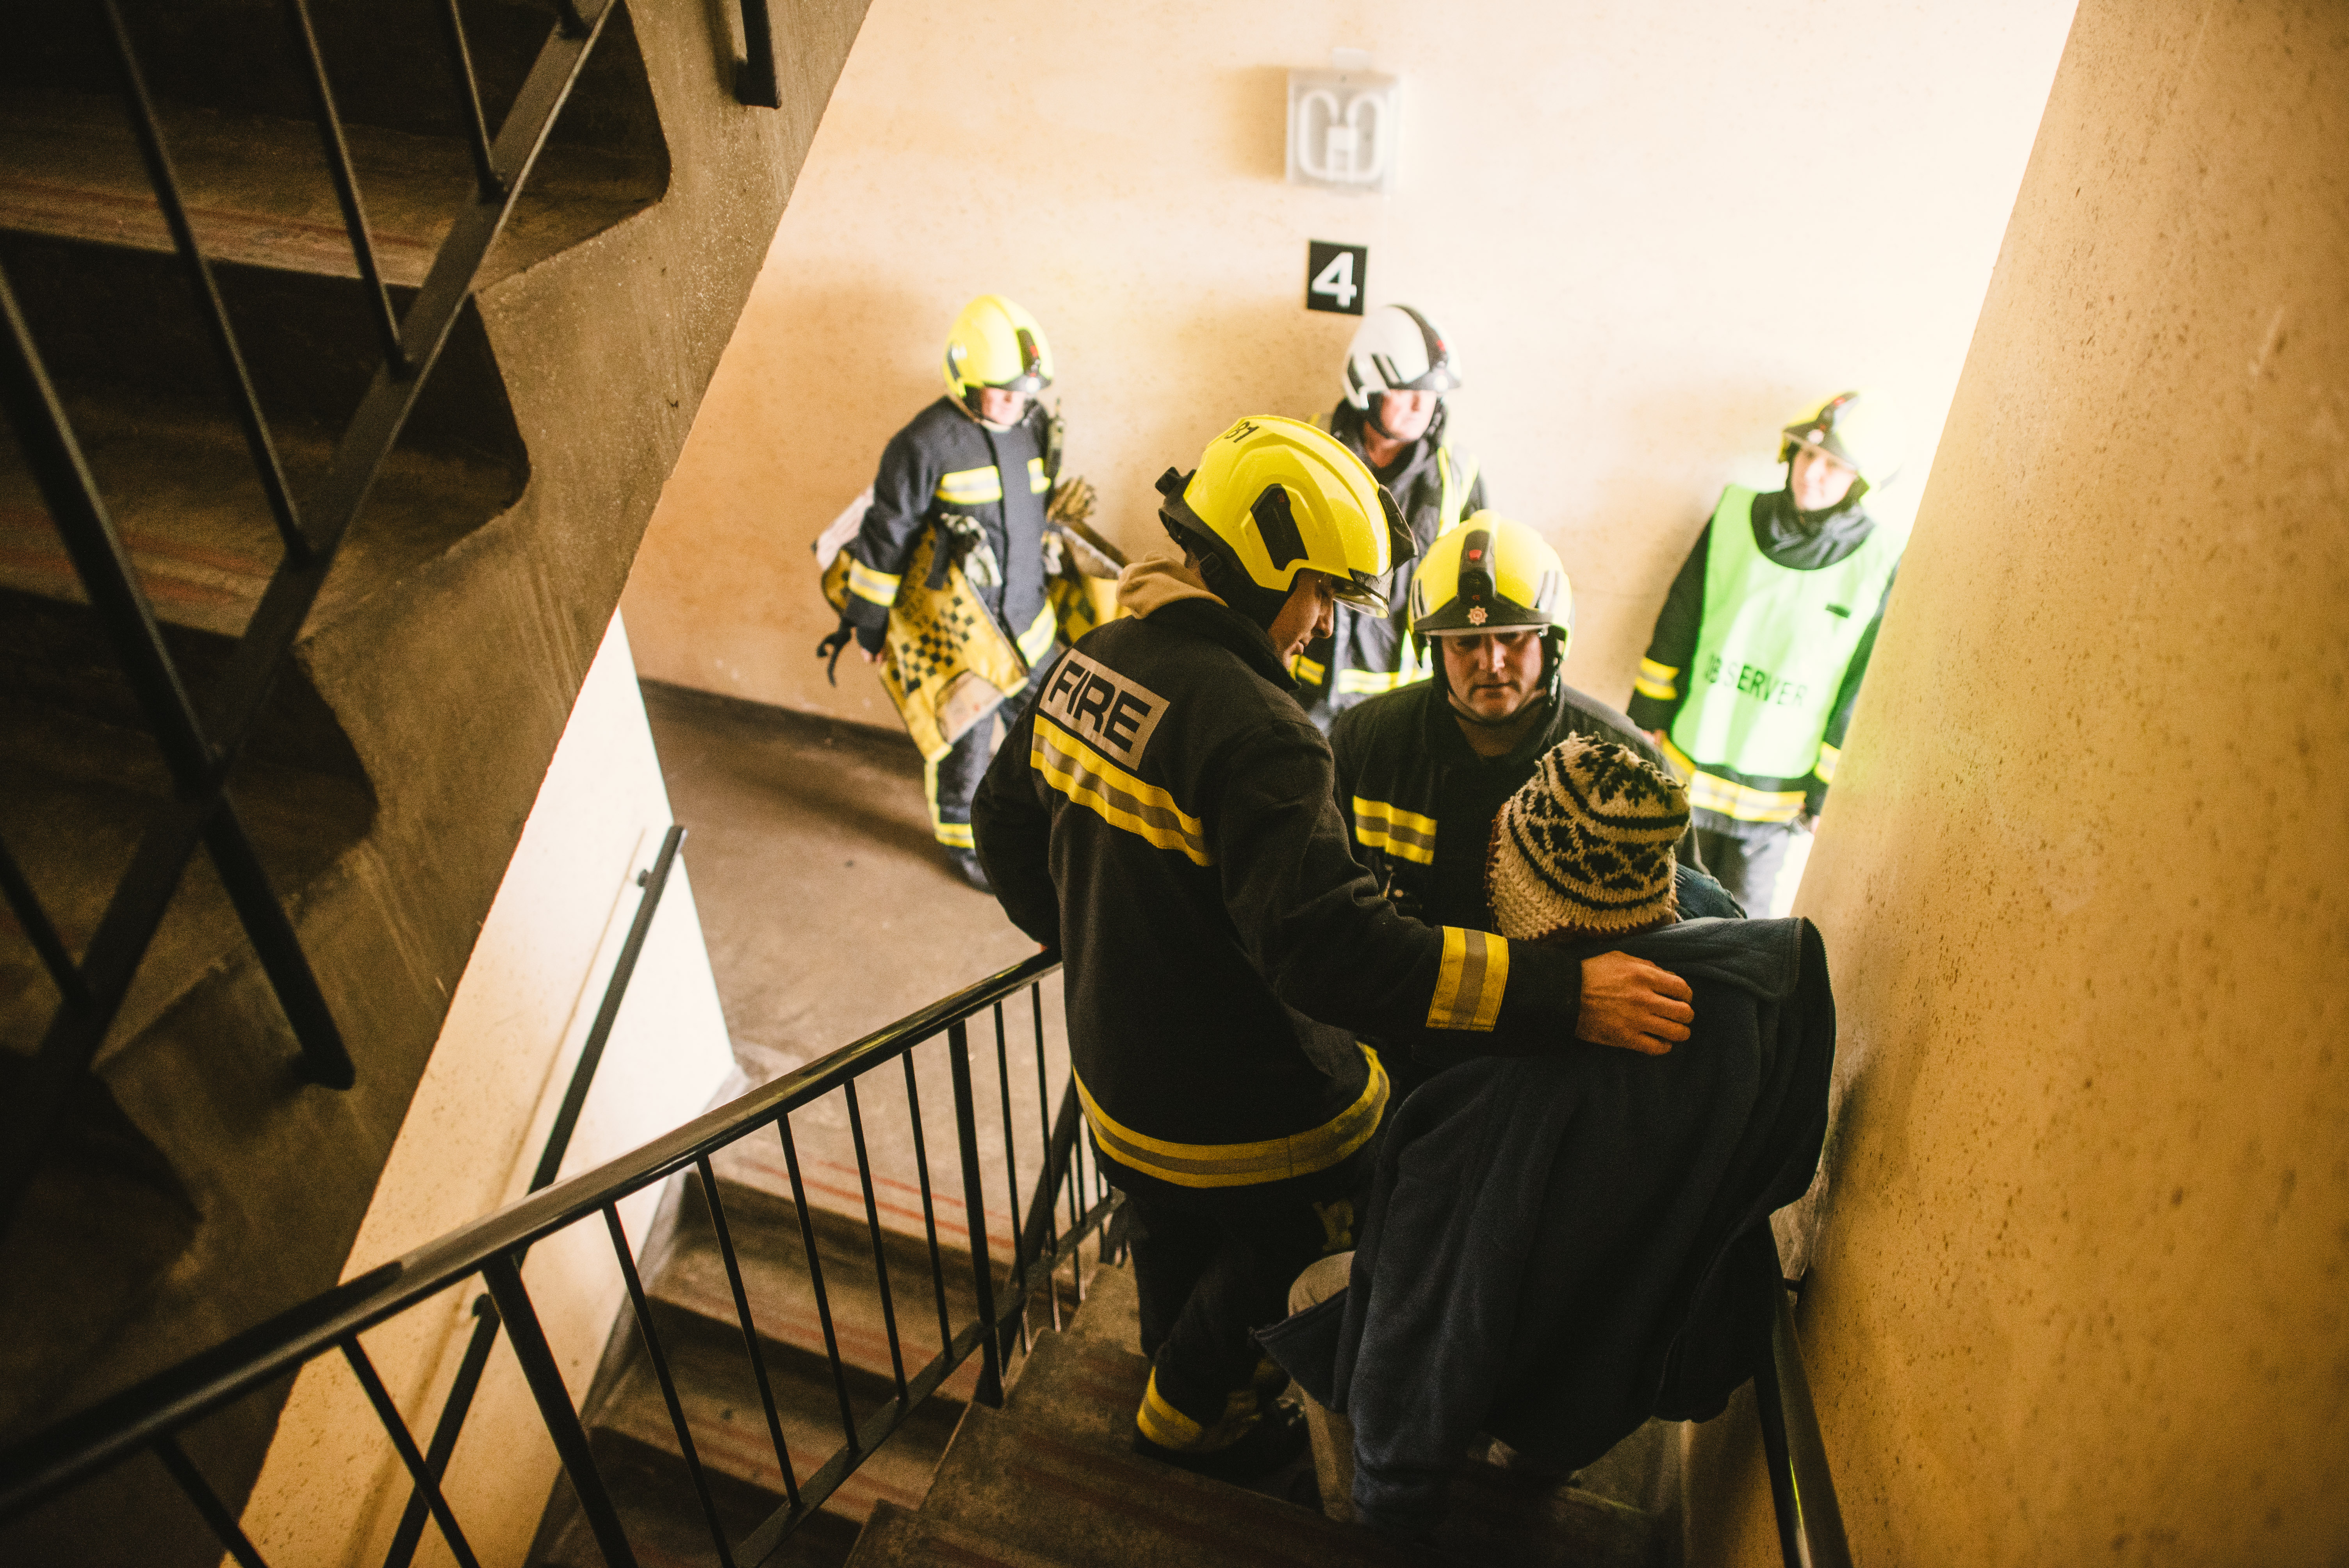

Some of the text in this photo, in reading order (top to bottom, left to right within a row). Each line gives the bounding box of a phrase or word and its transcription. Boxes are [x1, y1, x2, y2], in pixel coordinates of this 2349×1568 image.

[1311, 251, 1357, 308] 4
[1224, 421, 1260, 443] 81
[1048, 659, 1152, 754] FIRE
